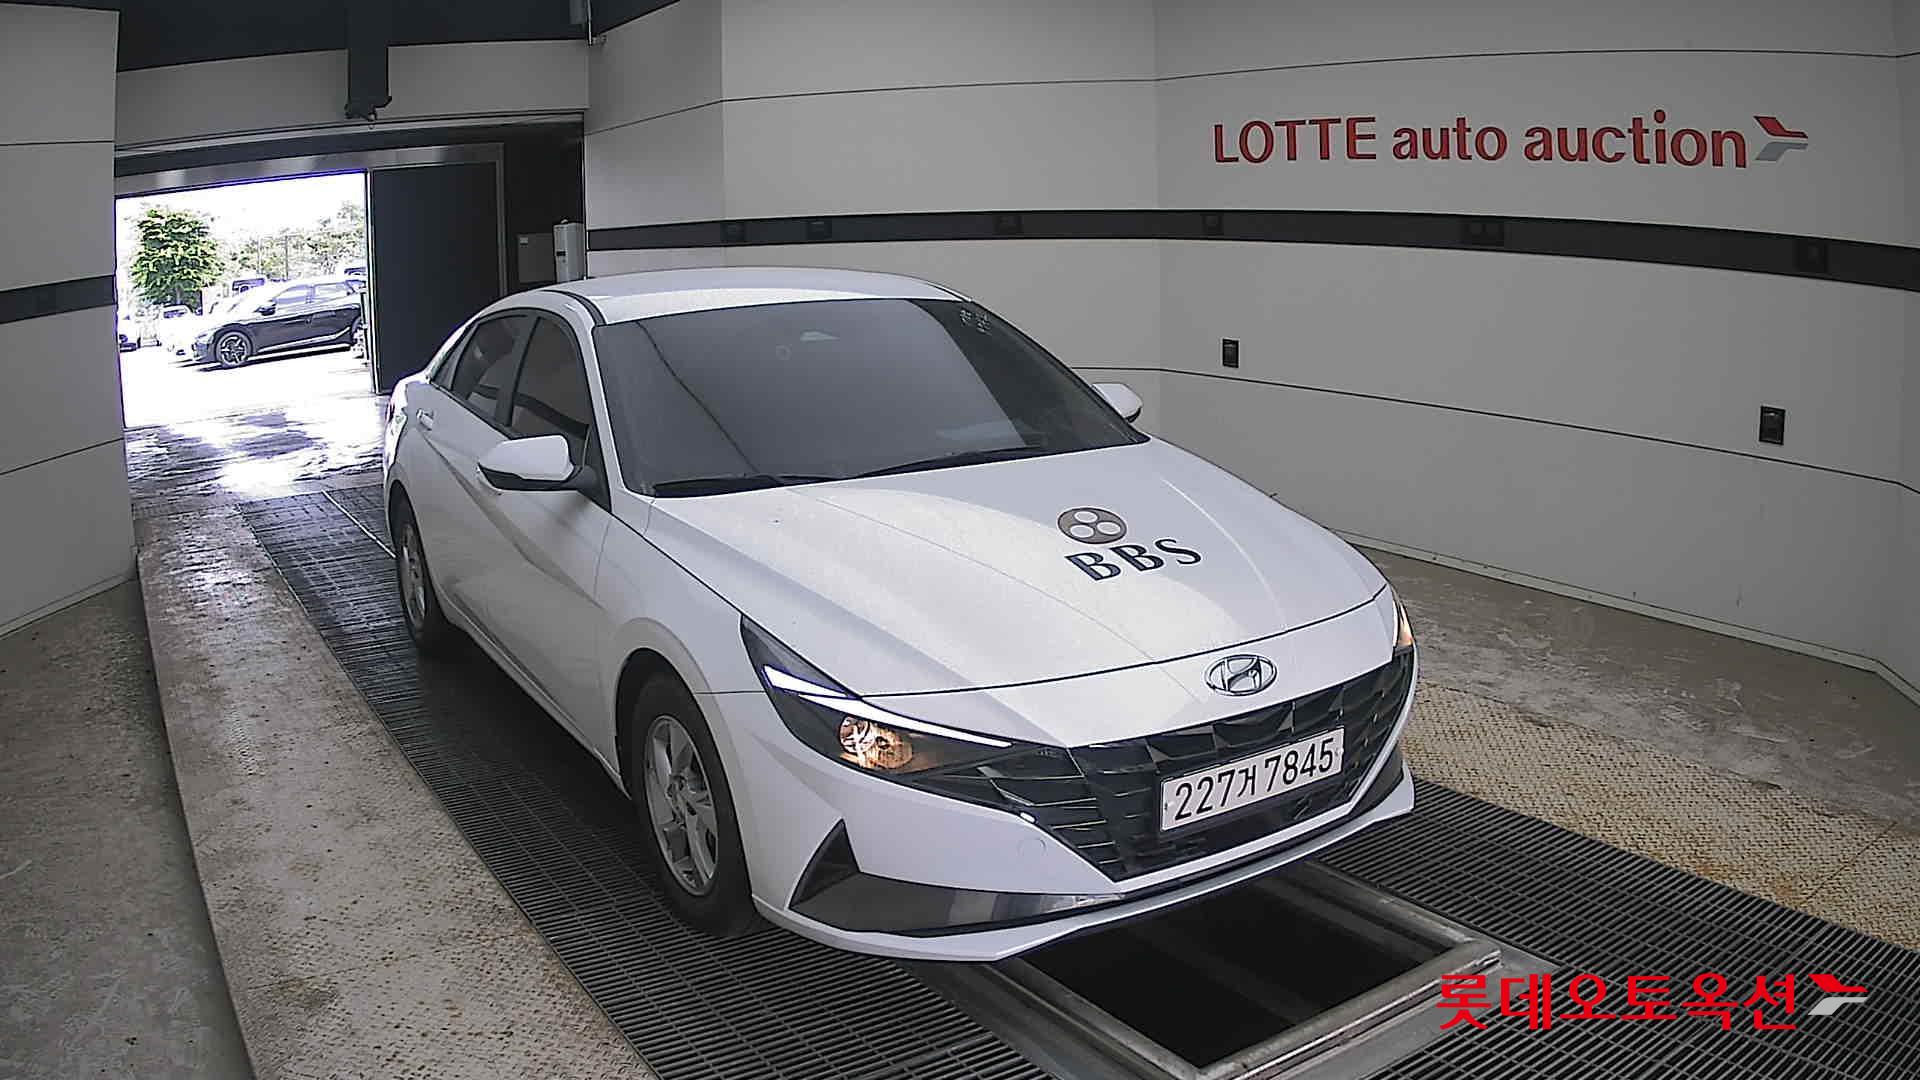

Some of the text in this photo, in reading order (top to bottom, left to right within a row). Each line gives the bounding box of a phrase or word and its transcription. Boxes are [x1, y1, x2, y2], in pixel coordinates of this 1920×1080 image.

[1213, 109, 1748, 169] LOTTE auto auction
[1064, 538, 1202, 581] BBS
